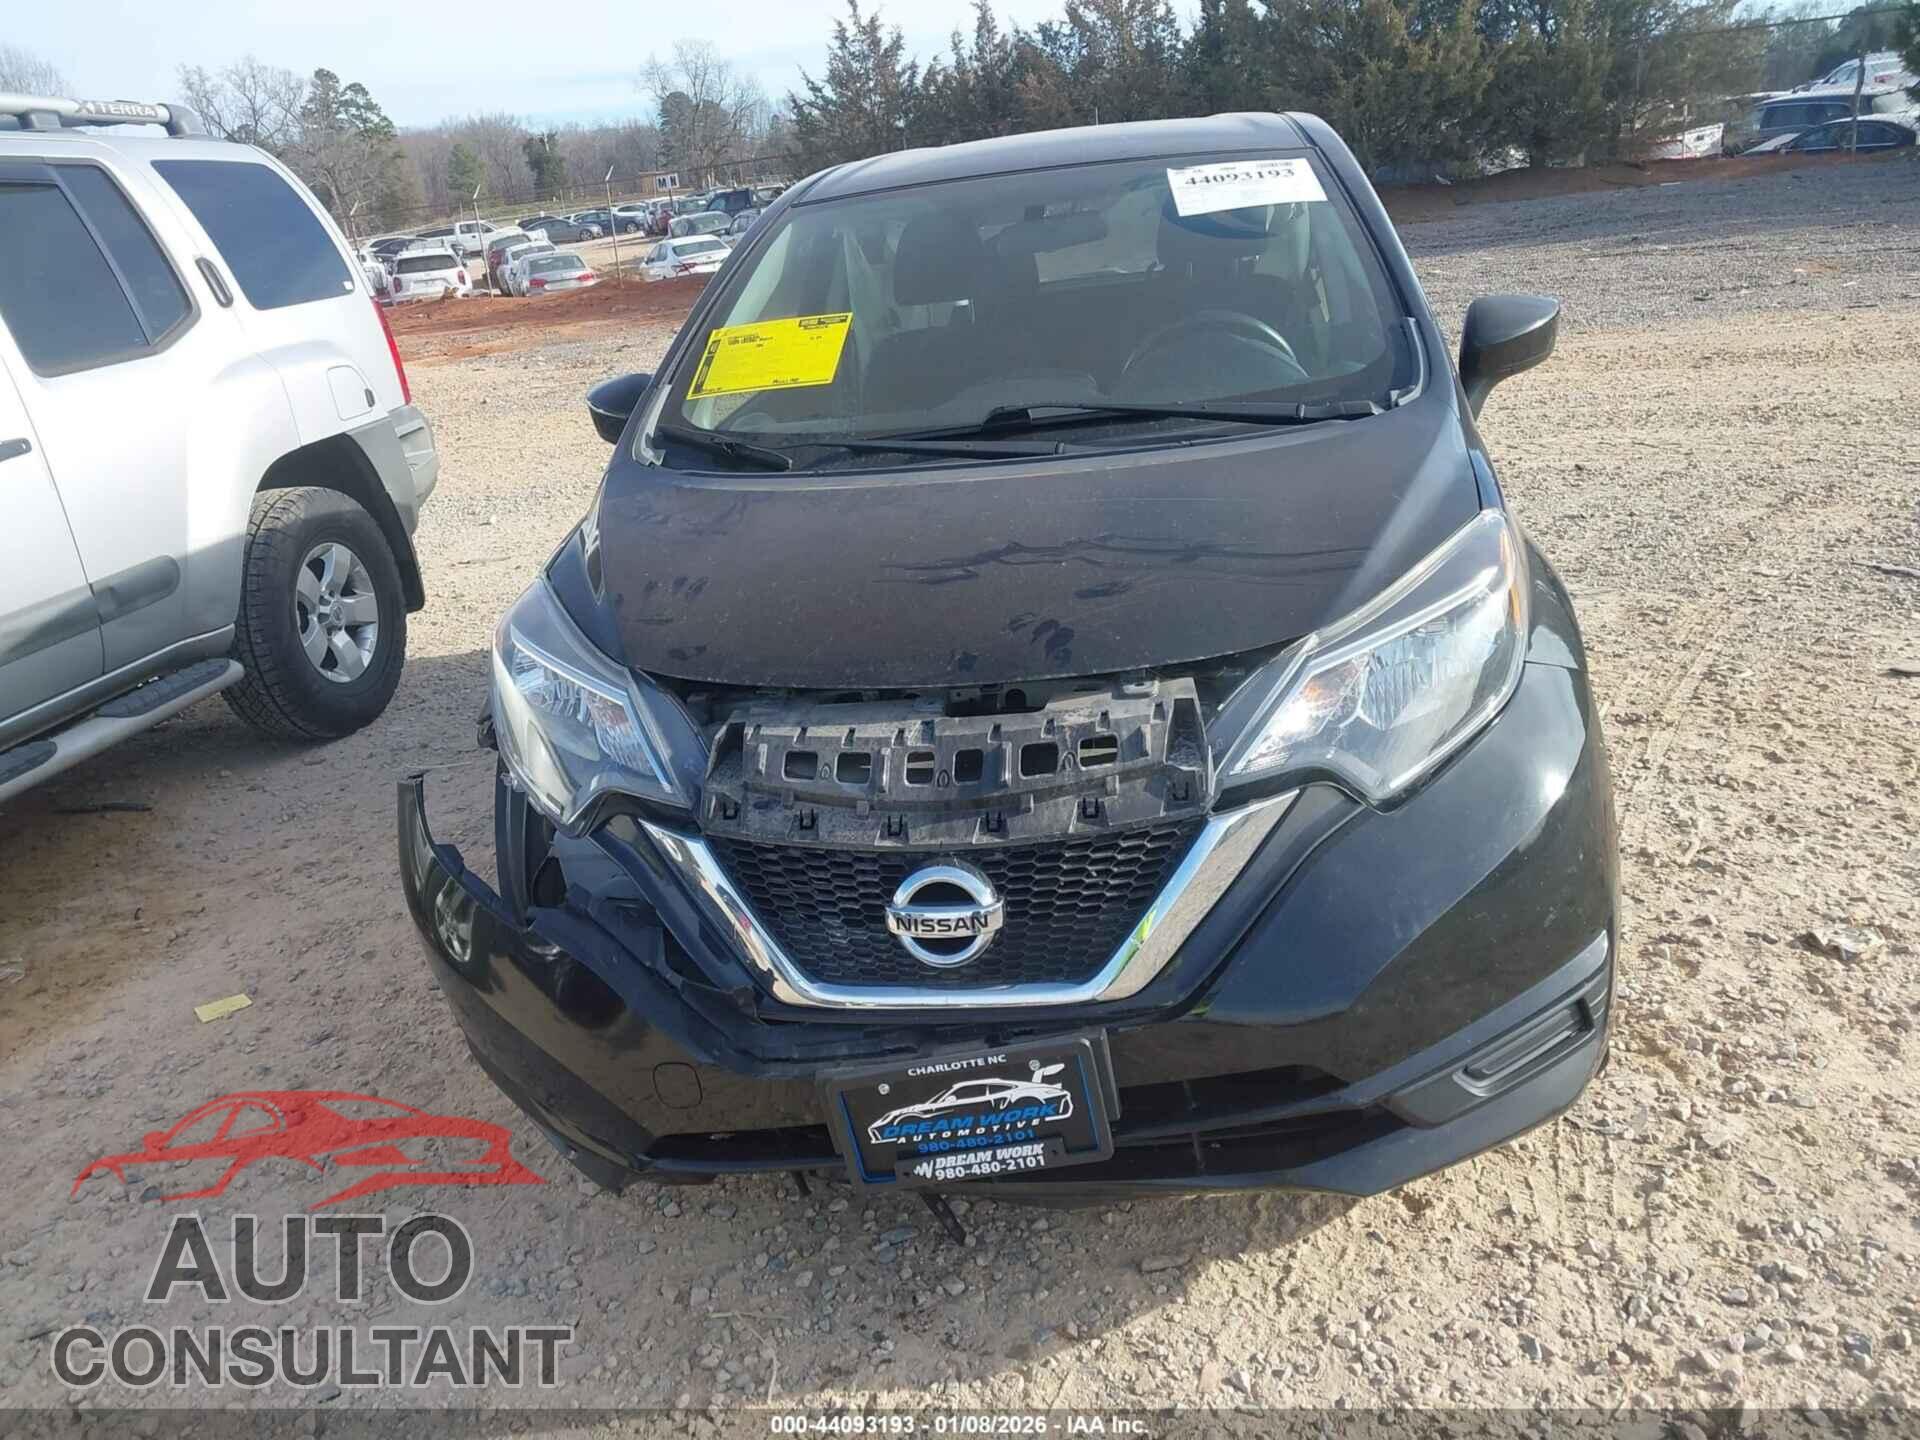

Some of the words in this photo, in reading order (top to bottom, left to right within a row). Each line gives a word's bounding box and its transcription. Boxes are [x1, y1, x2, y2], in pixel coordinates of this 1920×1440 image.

[1185, 168, 1295, 185] 44093193
[896, 914, 988, 933] NISSAN
[907, 1057, 986, 1076] CHARLOTTE
[988, 1054, 1007, 1066] NC
[883, 1114, 973, 1139] DREAM
[979, 1103, 1056, 1127] WORK
[896, 1118, 1041, 1144] AUTOMOTIVE
[918, 1129, 1036, 1154] 980-480-2101
[935, 1149, 993, 1169] DREAM
[996, 1143, 1045, 1161] WORK
[936, 1155, 1046, 1181] 980-480-2101
